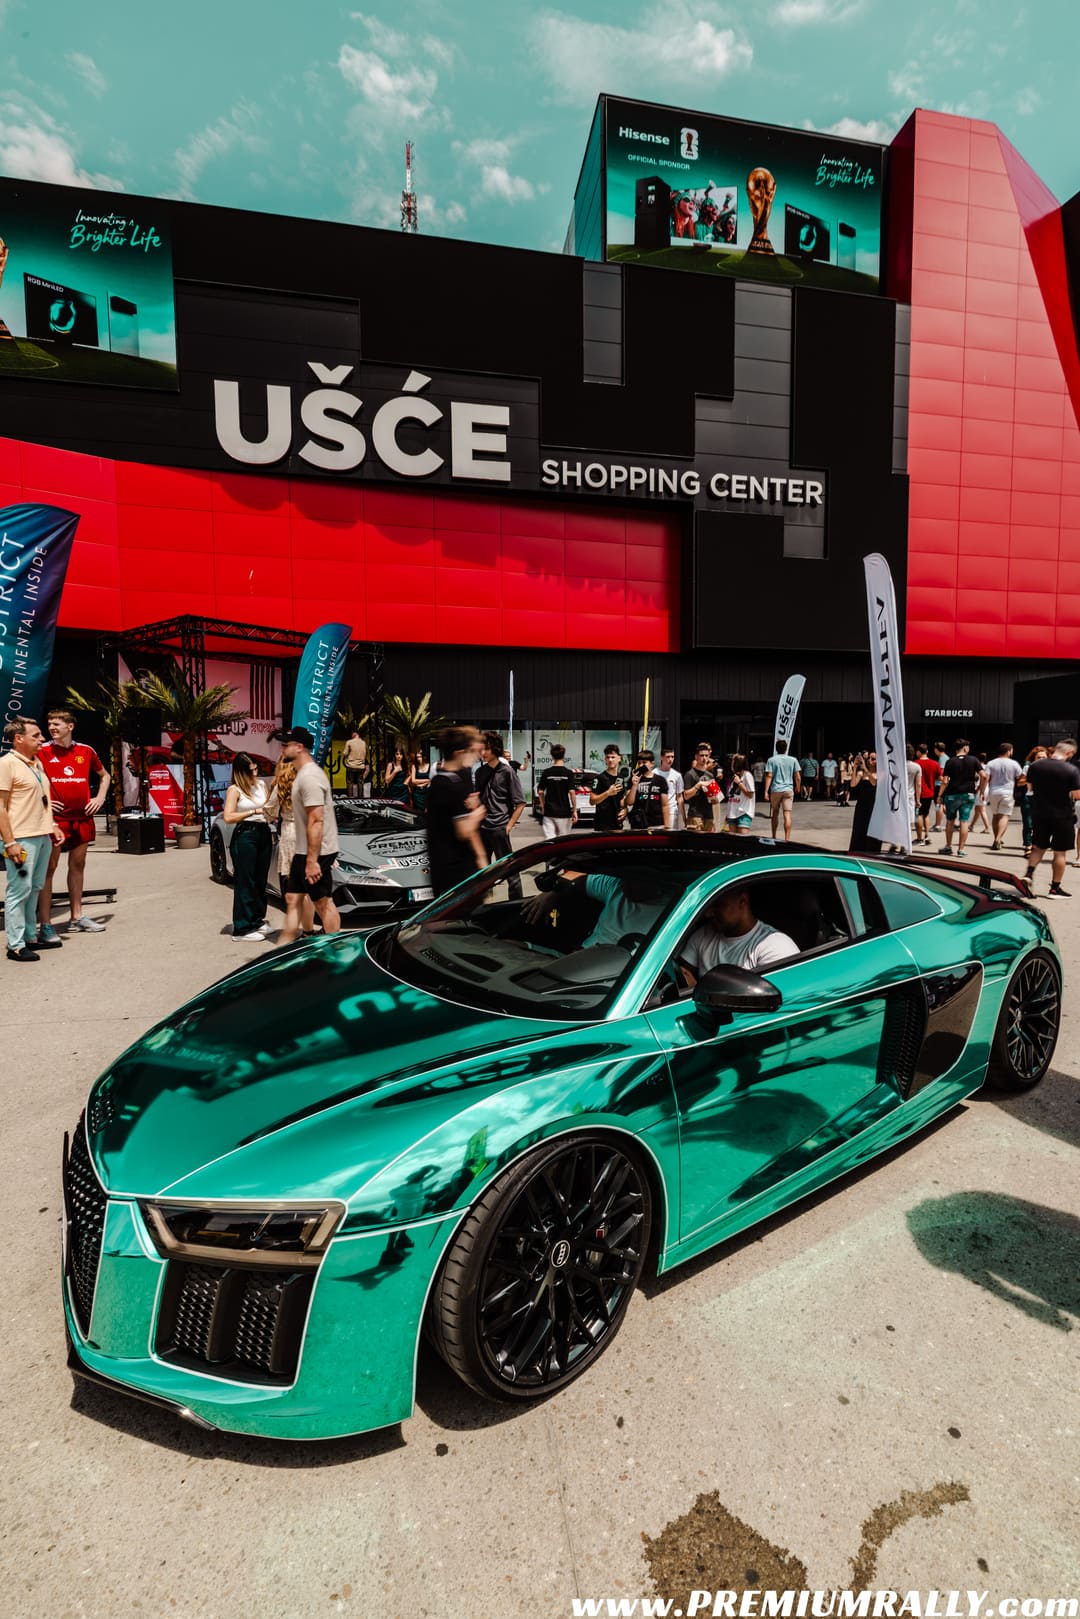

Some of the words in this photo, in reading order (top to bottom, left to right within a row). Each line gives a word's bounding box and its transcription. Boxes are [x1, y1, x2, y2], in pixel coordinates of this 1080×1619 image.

[619, 126, 670, 146] Hisense
[627, 153, 658, 165] OFFICIAL
[659, 159, 690, 171] SPONSOR
[820, 153, 853, 171] Innovating
[815, 165, 853, 188] Brighter
[854, 165, 876, 189] Life
[75, 209, 126, 231] Innovating
[69, 224, 127, 252] Brighter
[130, 224, 162, 252] Life
[213, 361, 511, 482] UŠĆE
[541, 459, 700, 496] SHOPPING
[710, 473, 824, 505] CENTER
[23, 545, 48, 601] INSIDE
[327, 645, 339, 678] INSIDE
[308, 640, 329, 714] DISTRICT
[778, 694, 795, 736] UŠĆE
[924, 709, 974, 718] STARBUCKS
